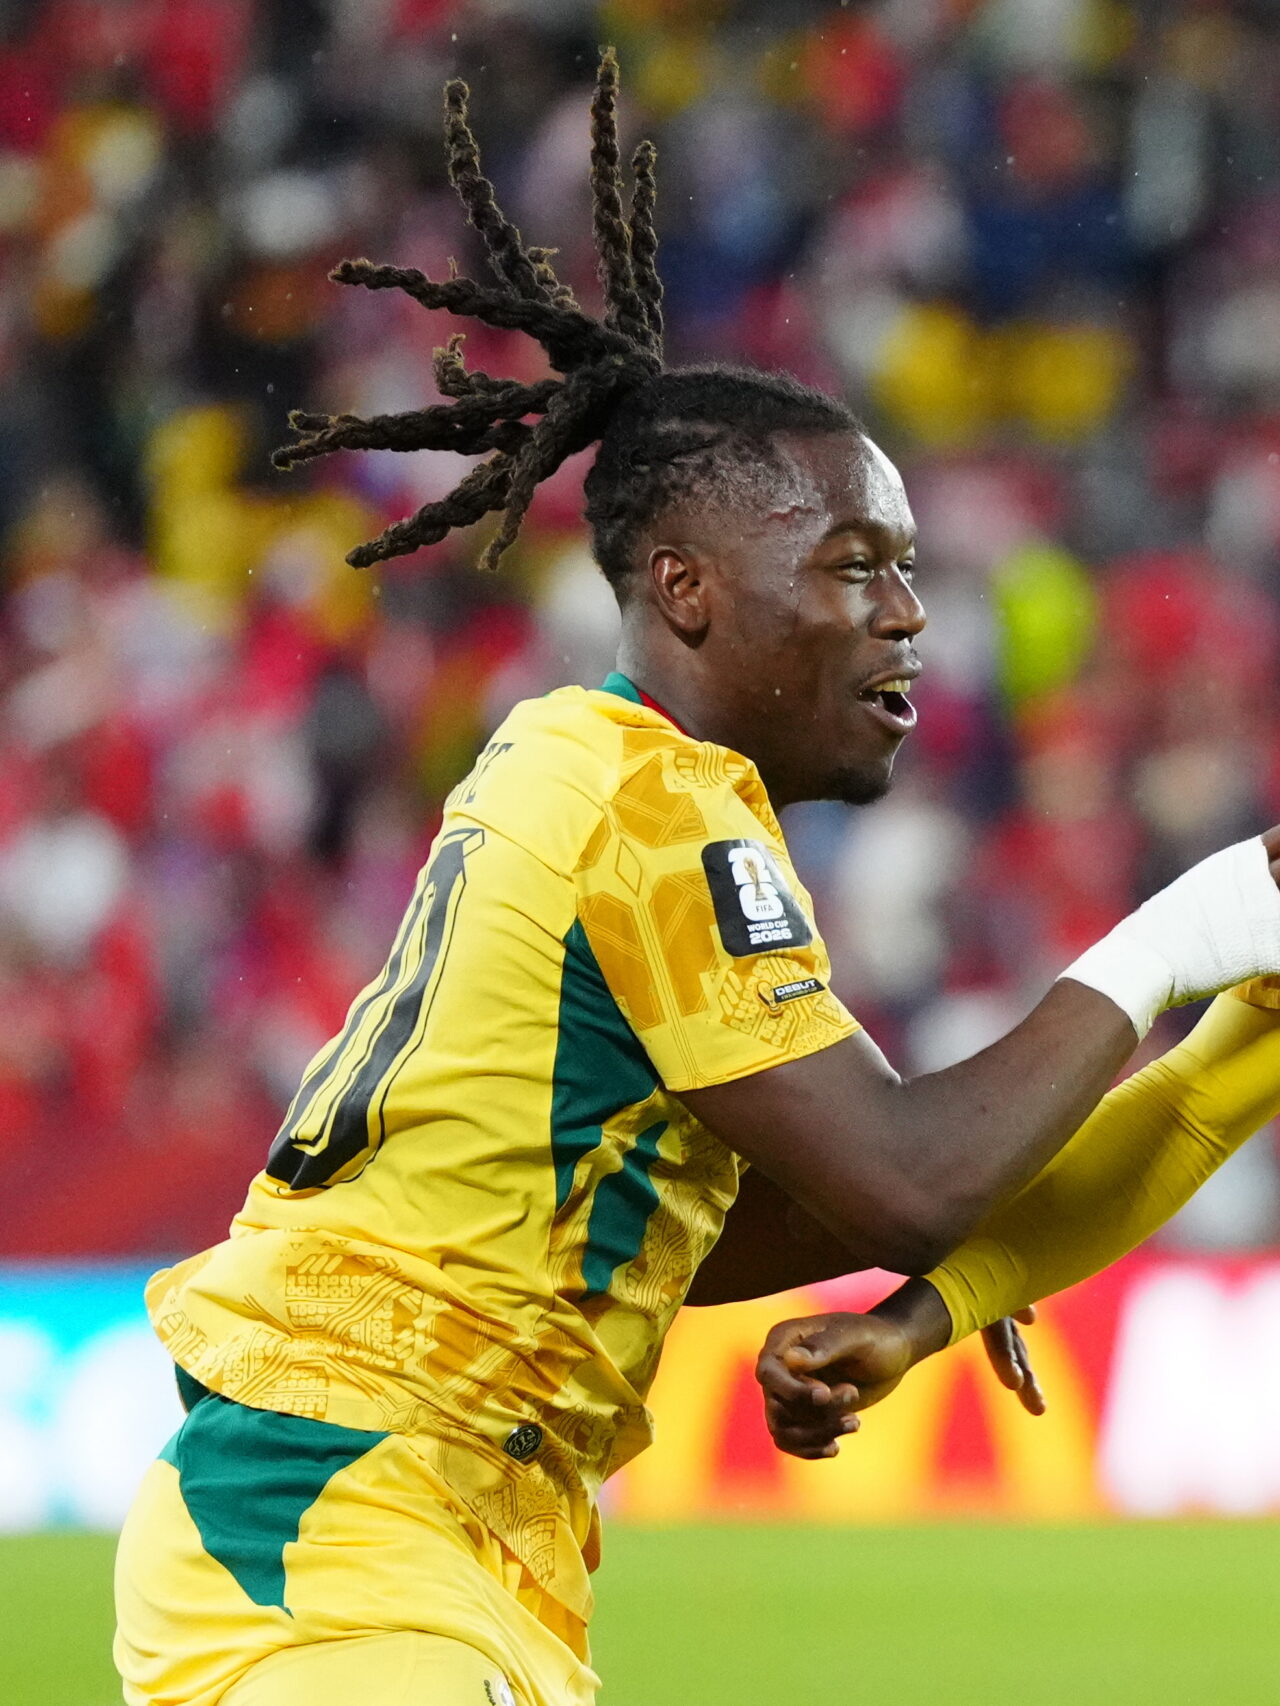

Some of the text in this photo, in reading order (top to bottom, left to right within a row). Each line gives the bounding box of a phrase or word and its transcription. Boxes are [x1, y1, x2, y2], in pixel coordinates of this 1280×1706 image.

[755, 905, 774, 914] FIFA
[747, 920, 789, 932] WORLD CUP
[749, 928, 792, 945] 2026
[775, 979, 816, 996] DEBUT
